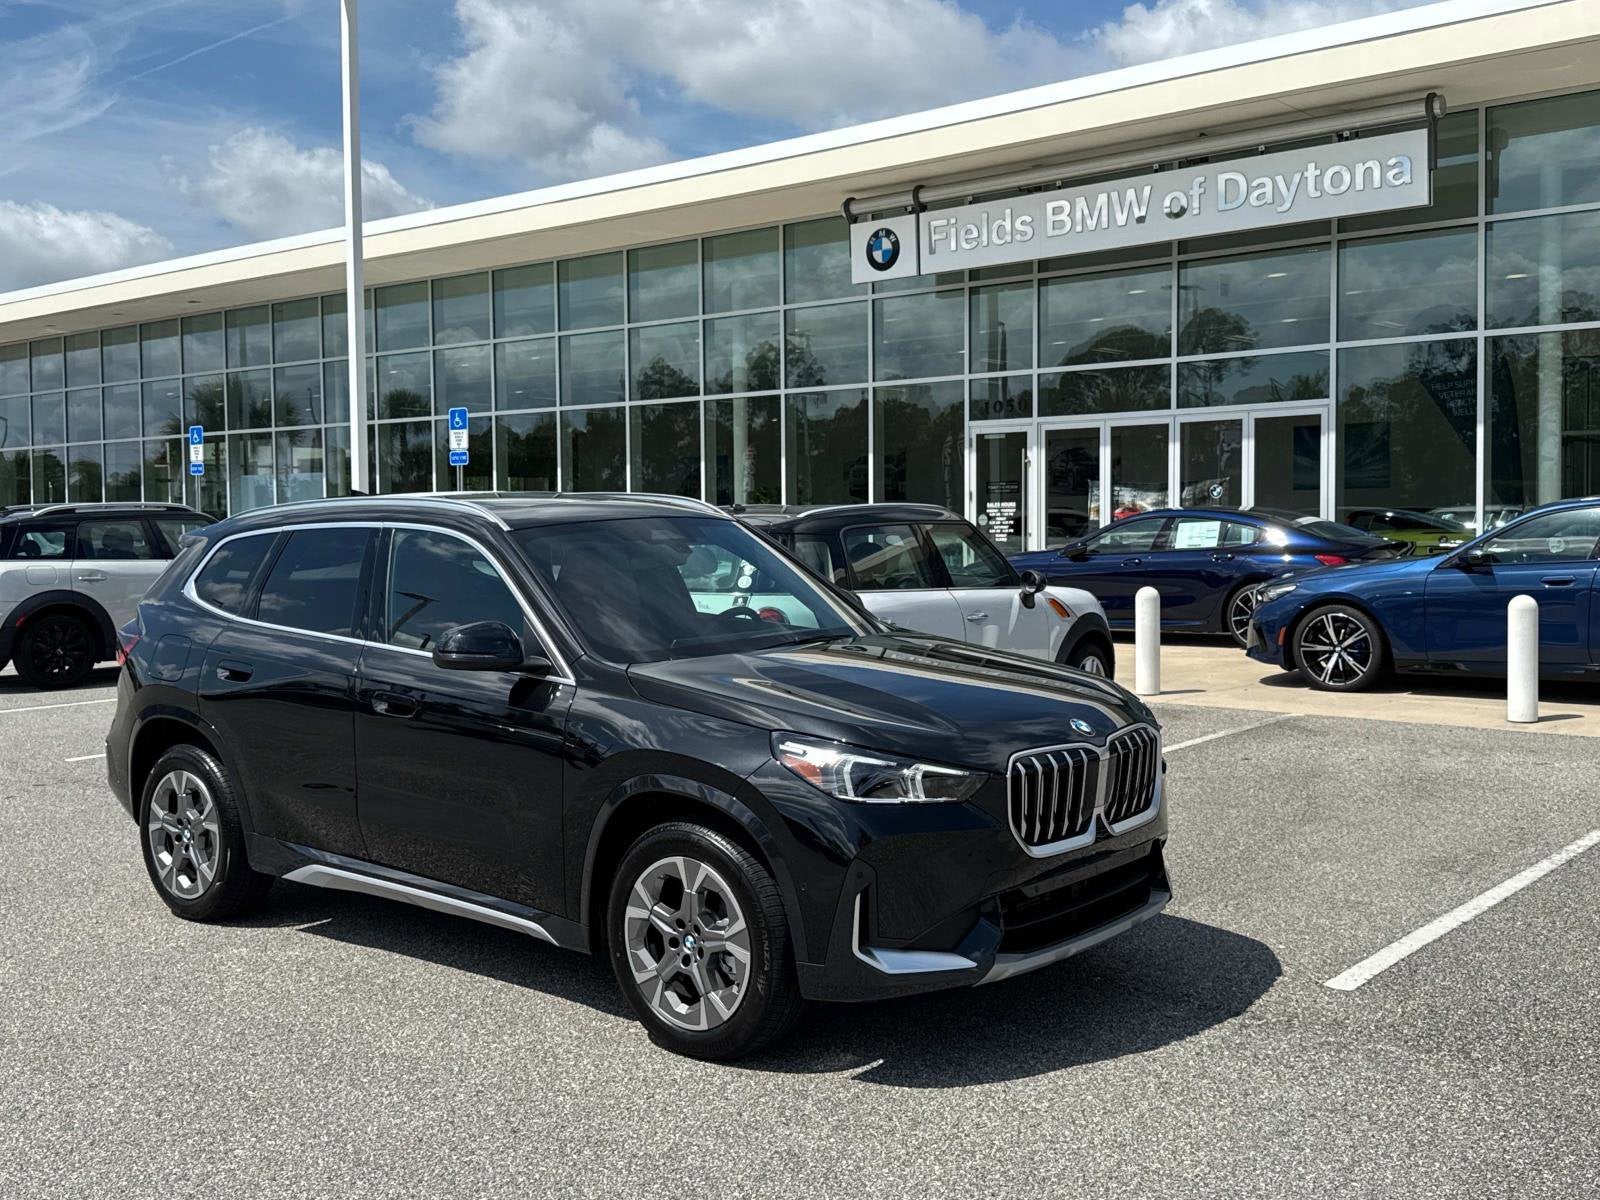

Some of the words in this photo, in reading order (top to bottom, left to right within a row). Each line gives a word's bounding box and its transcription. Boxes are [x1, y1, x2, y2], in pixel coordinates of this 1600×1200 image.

[928, 208, 1035, 255] Fields
[1046, 185, 1152, 238] BMW
[1162, 175, 1206, 220] of
[1216, 153, 1413, 214] Daytona
[984, 397, 1027, 415] 1050
